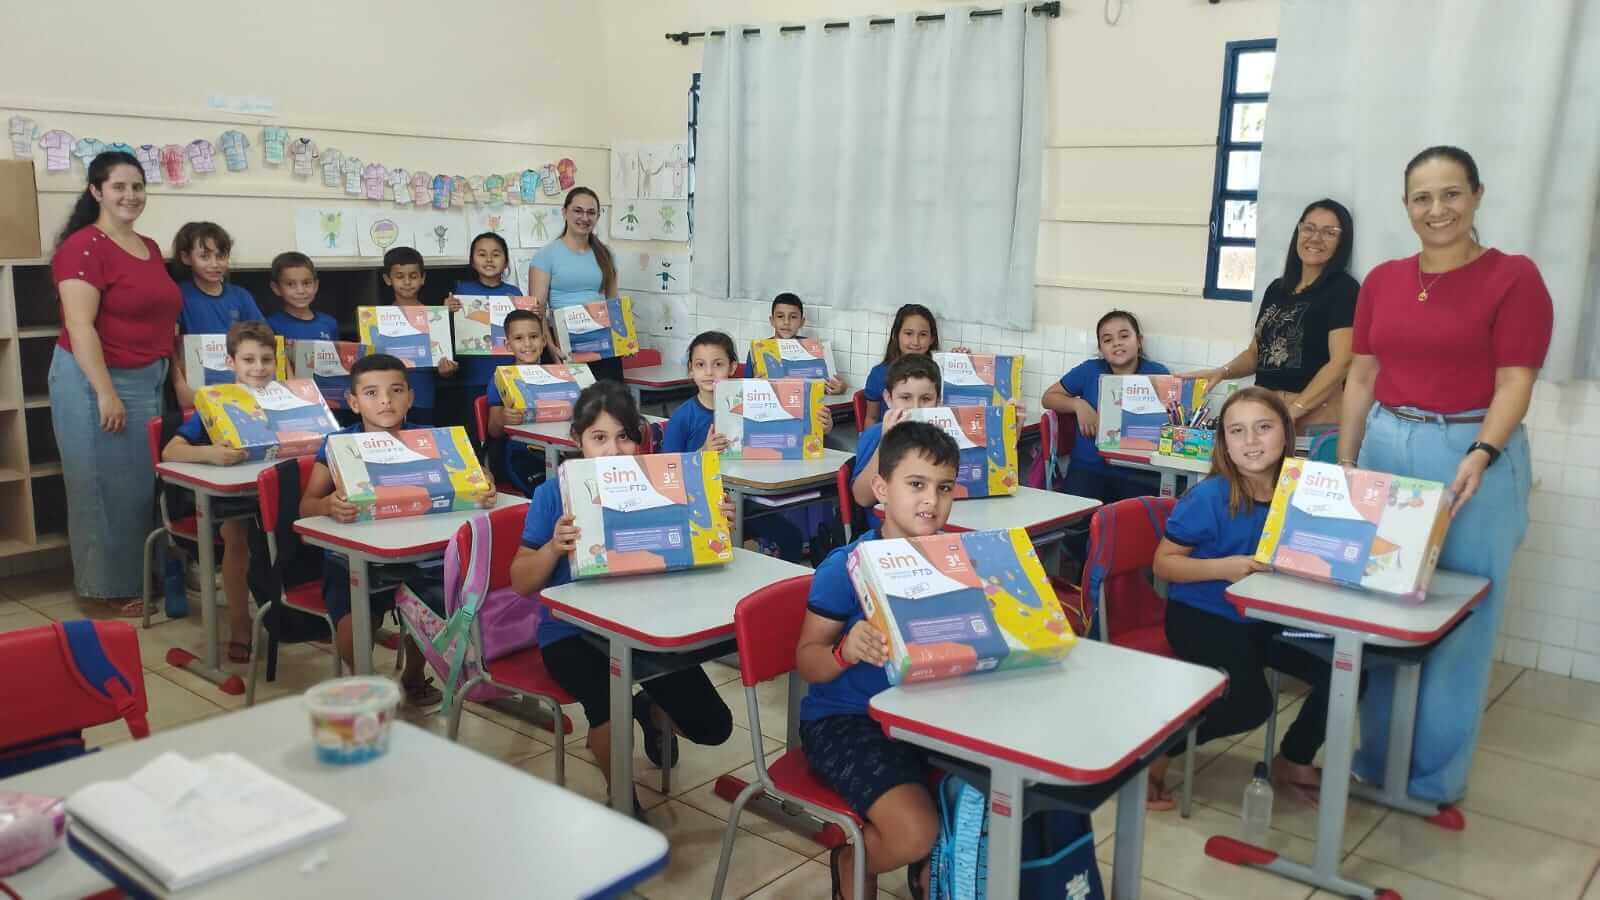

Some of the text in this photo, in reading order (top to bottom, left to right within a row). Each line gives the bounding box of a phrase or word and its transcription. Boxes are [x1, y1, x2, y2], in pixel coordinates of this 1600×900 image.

[747, 388, 771, 401] sim
[1126, 384, 1150, 395] sim
[363, 437, 394, 449] sim
[603, 466, 637, 484] sim
[1305, 471, 1340, 490] sim
[629, 483, 648, 493] FTD
[879, 552, 918, 570] sim
[911, 567, 932, 577] FTD
